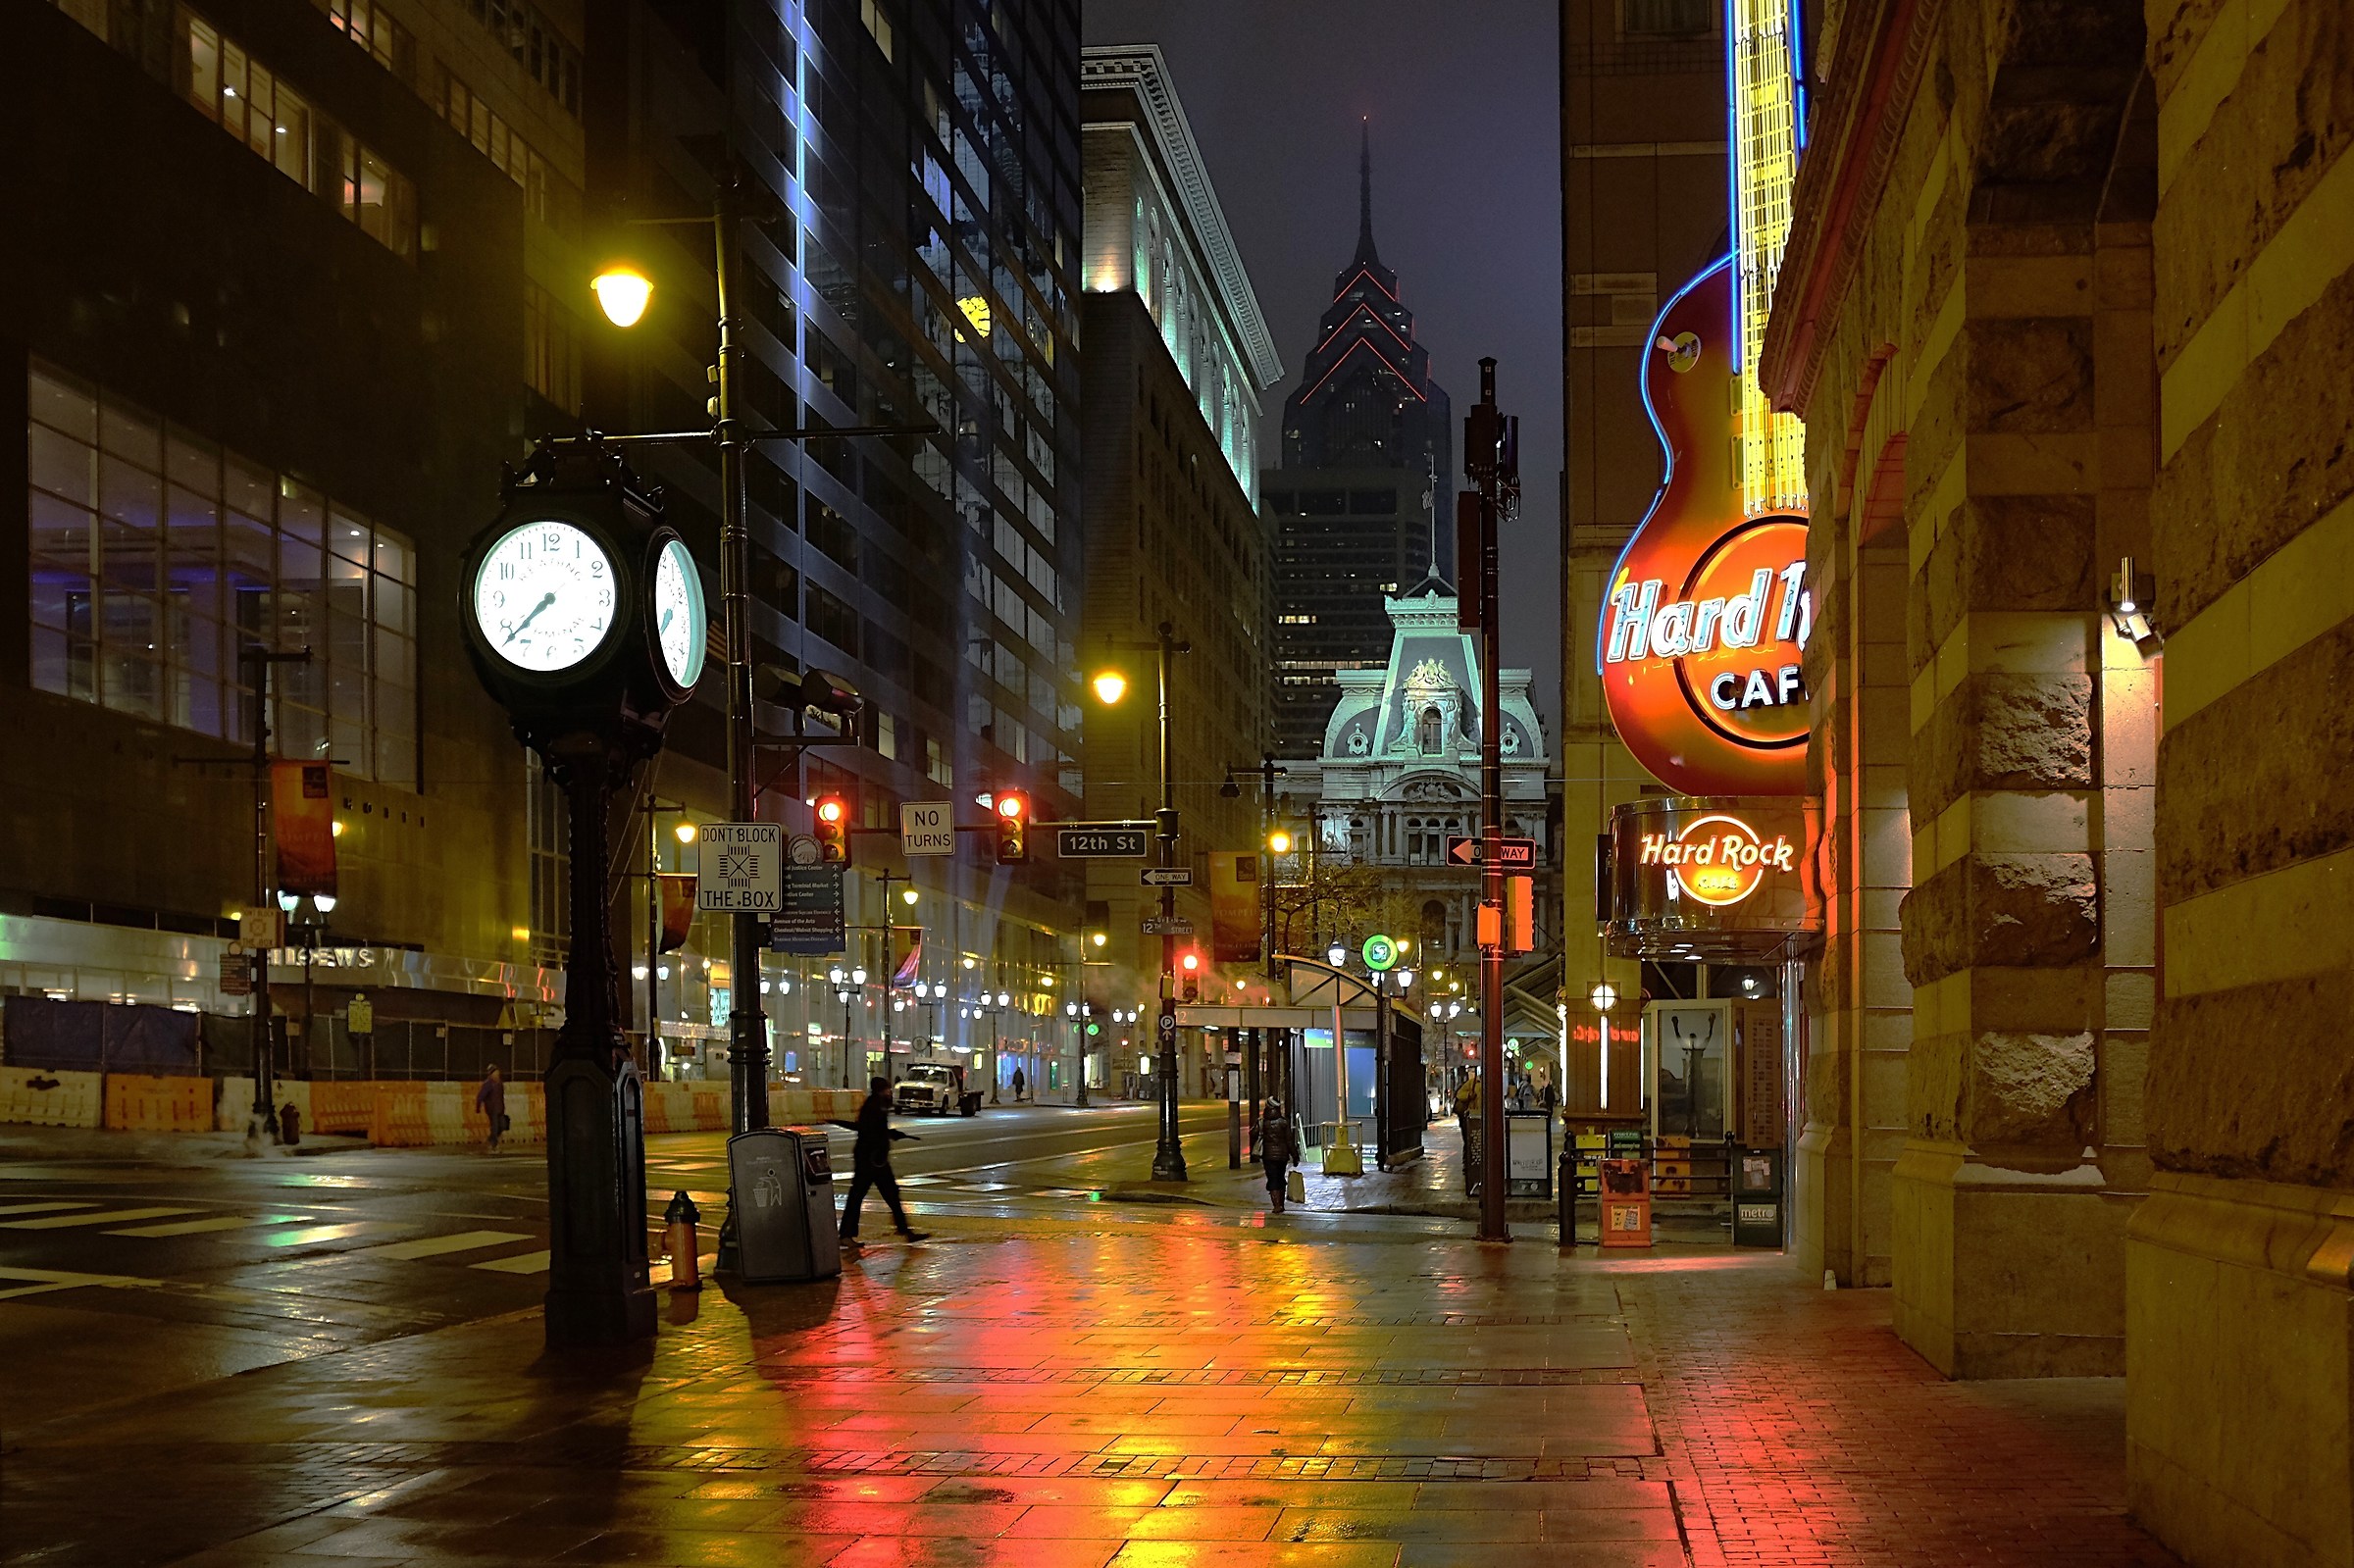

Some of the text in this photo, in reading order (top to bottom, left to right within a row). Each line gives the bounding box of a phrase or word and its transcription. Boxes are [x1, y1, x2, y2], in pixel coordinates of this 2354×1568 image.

[520, 541, 533, 560] 11
[542, 532, 561, 552] 12
[575, 539, 581, 559] 1
[499, 561, 515, 581] 10
[590, 560, 604, 579] 2
[492, 589, 506, 609] 9
[598, 588, 611, 608] 3
[1607, 567, 1774, 663] Hard
[520, 638, 532, 657] 7
[545, 645, 557, 661] 6
[573, 637, 586, 655] 5
[1711, 665, 1809, 711] CAF
[914, 810, 940, 827] NO
[702, 828, 776, 843] DON'T BLOCK
[905, 834, 951, 848] TURNS
[1069, 836, 1136, 850] 12th St
[1501, 848, 1525, 859] WAY
[1640, 834, 1794, 873] Hard Rock
[704, 890, 775, 907] THE BOX
[1741, 1208, 1774, 1218] metro
